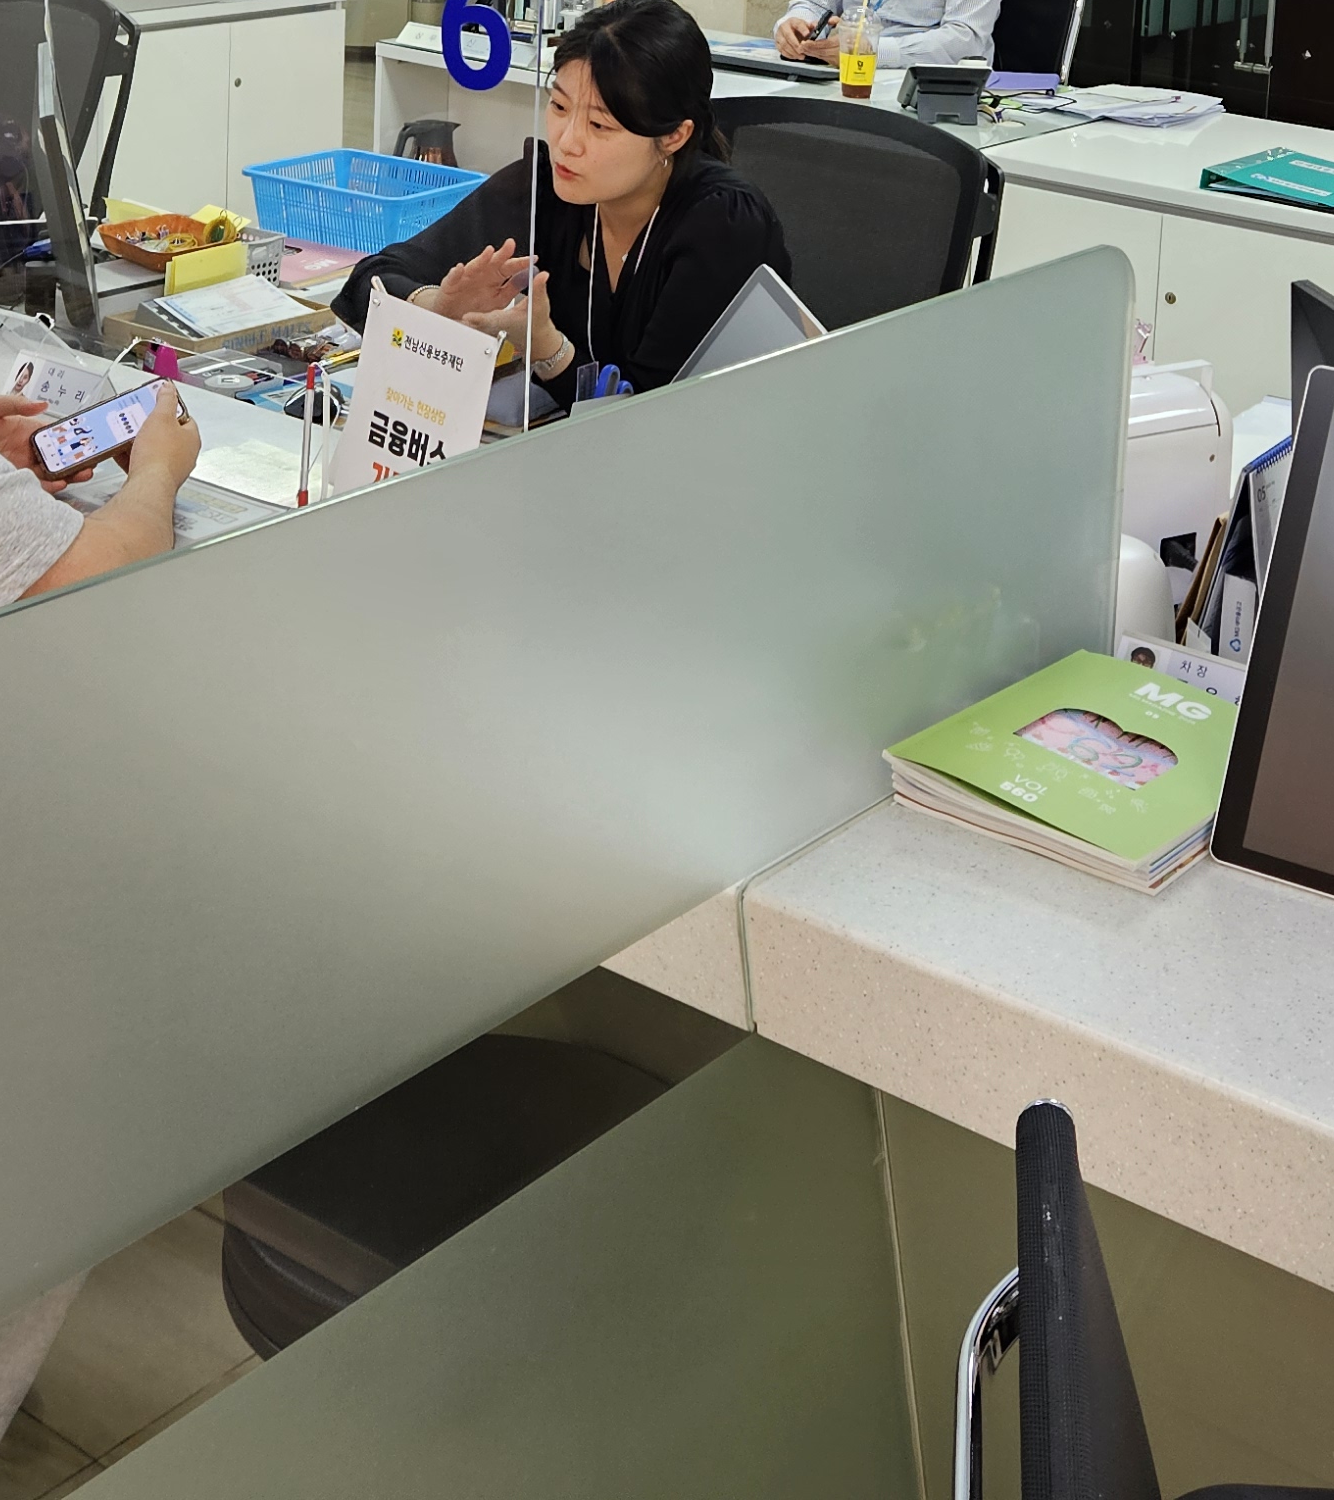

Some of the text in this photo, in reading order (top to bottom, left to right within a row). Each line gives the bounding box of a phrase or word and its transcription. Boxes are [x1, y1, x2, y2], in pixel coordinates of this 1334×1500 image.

[404, 335, 464, 372] 전남신용보증재단
[386, 387, 447, 426] 찾아가는 현장상담
[1134, 682, 1211, 720] MG
[1015, 774, 1048, 796] VOL
